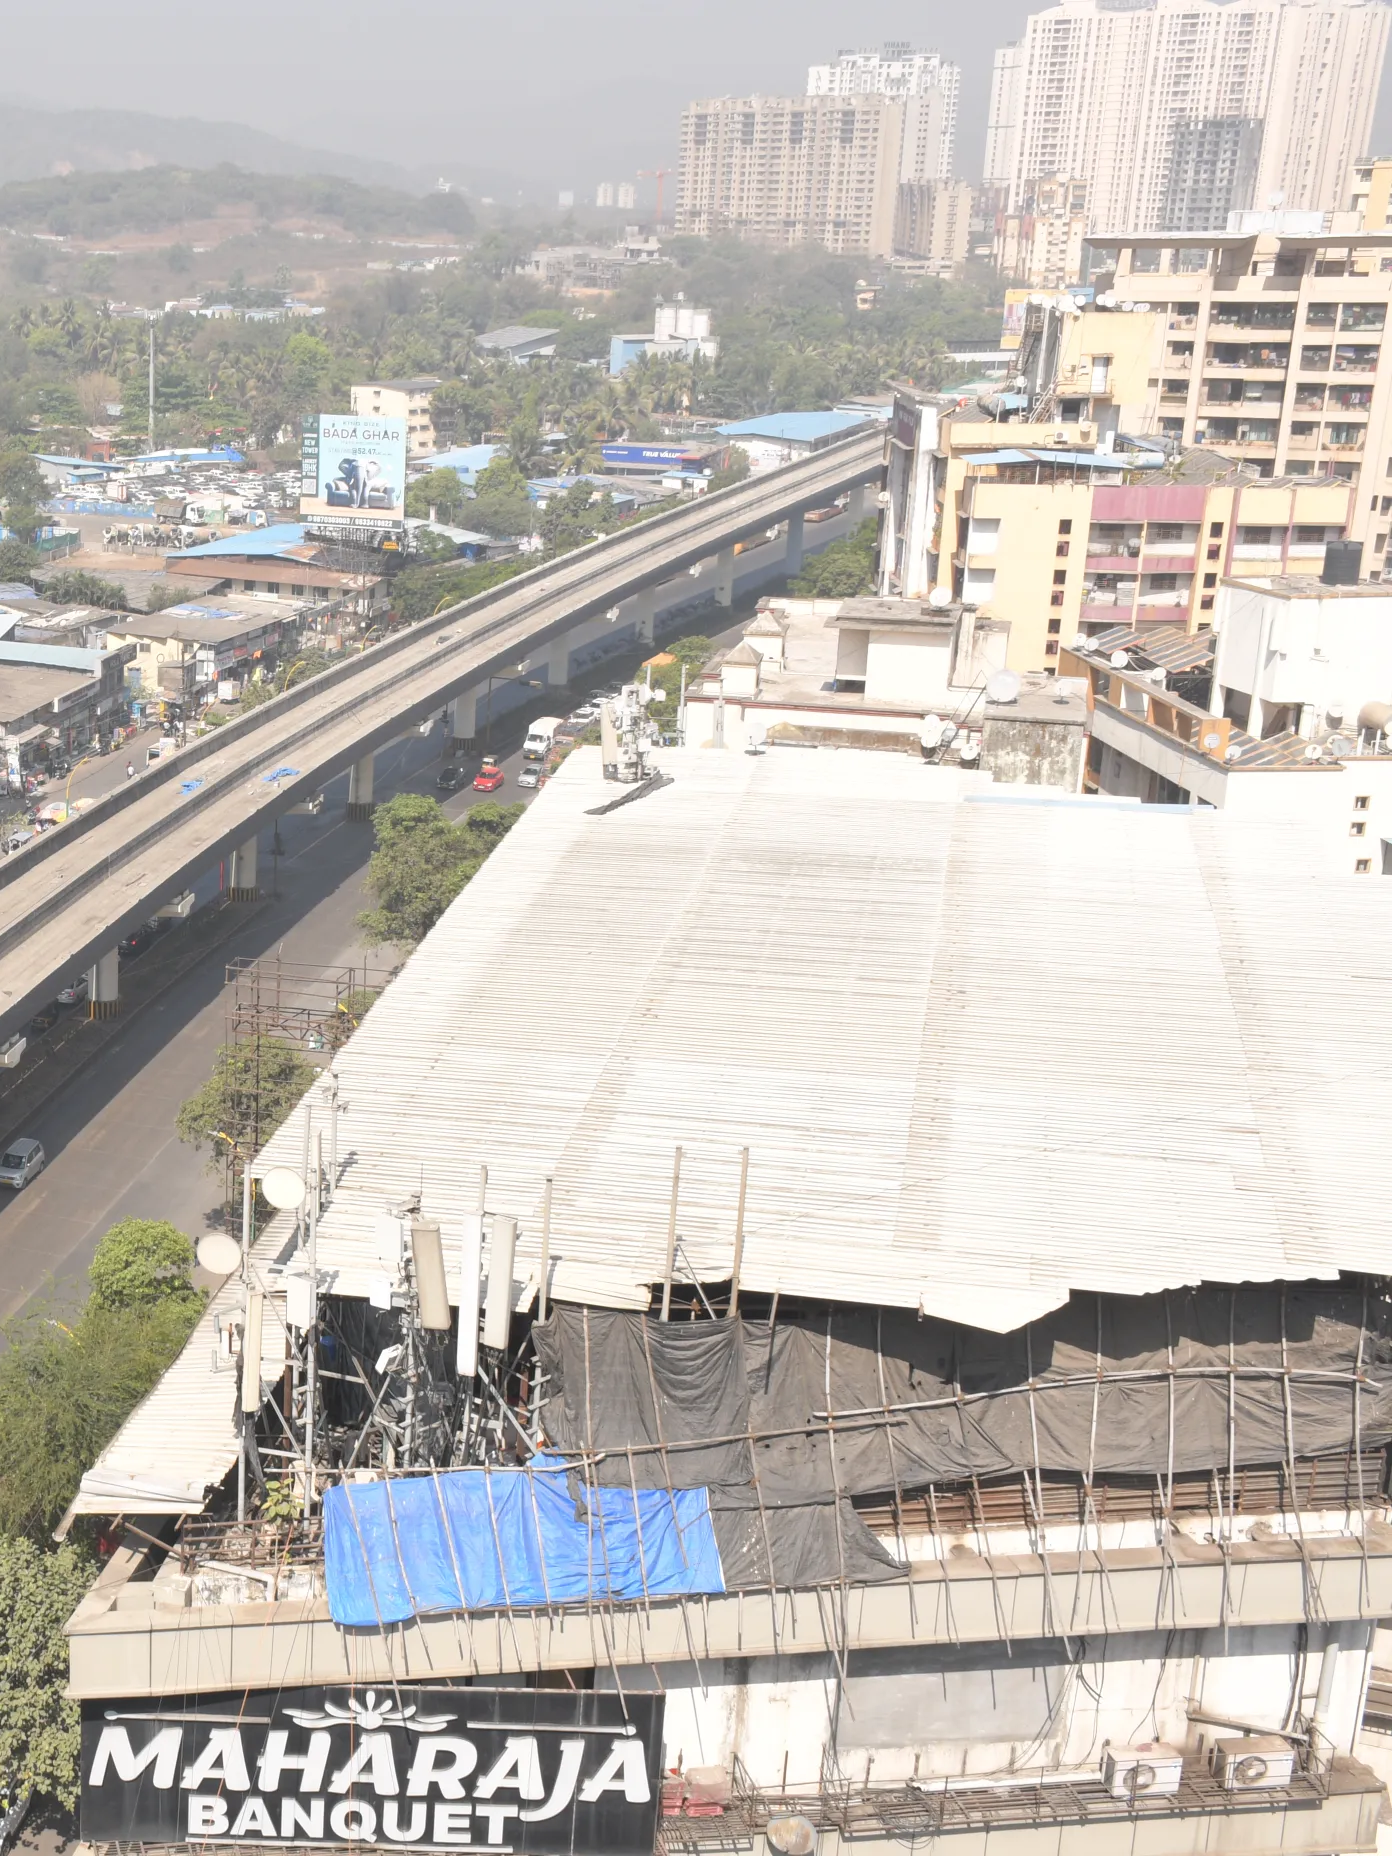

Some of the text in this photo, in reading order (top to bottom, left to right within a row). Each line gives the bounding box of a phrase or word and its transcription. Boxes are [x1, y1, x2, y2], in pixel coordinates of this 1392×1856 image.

[323, 428, 358, 439] BADA
[362, 430, 400, 441] GHAR
[642, 450, 659, 458] TRUE
[88, 1723, 651, 1822] MAHARAJA
[186, 1793, 521, 1843] BANQUET
